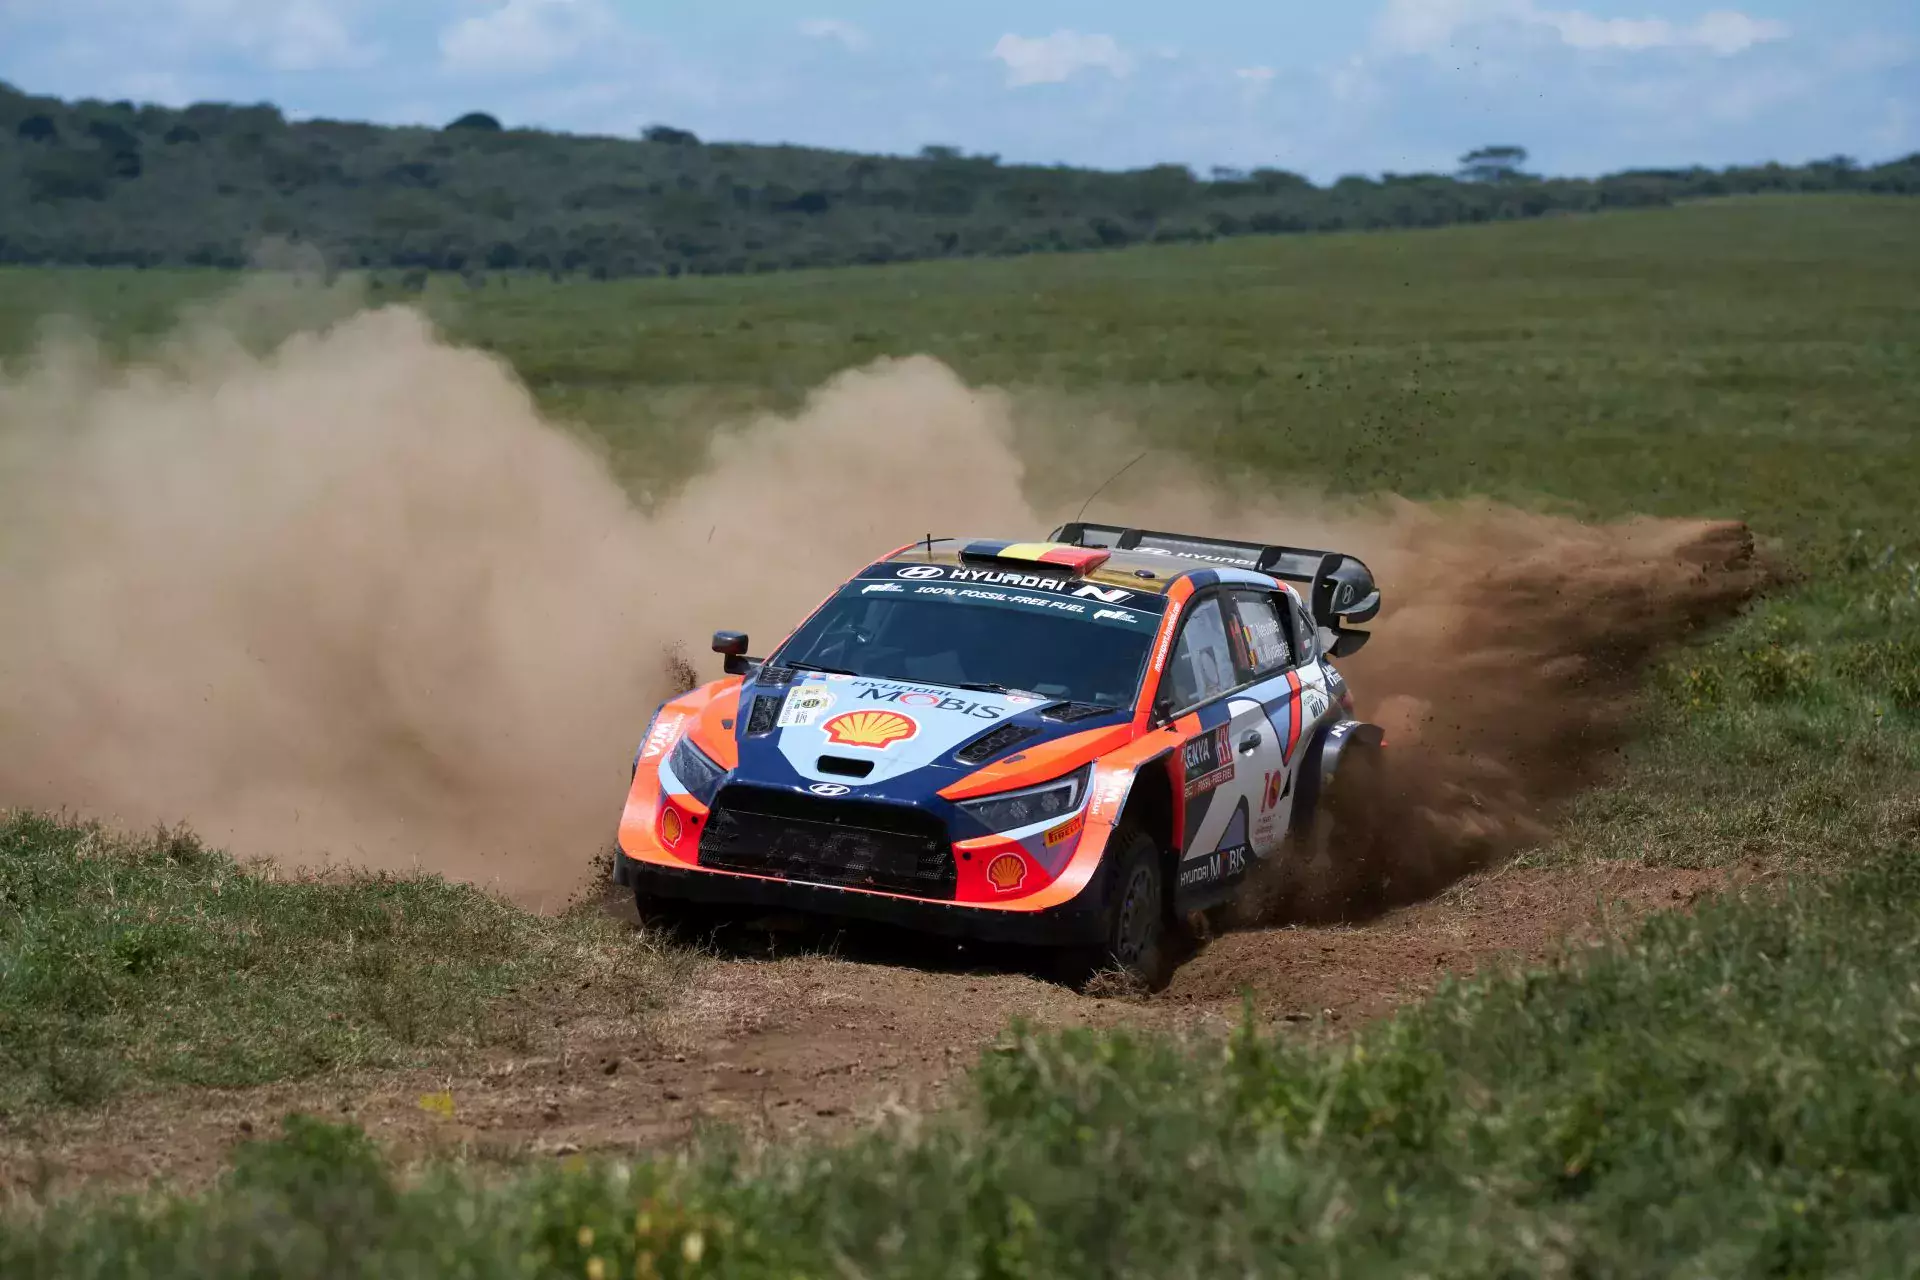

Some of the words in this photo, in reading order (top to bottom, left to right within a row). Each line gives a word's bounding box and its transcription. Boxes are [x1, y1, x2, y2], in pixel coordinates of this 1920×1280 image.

[949, 568, 1066, 592] HYUNDAI
[914, 586, 956, 596] 100%
[958, 588, 1050, 607] FOSSIL-FREE
[1049, 599, 1086, 614] FUEL
[850, 681, 950, 698] HYUNDAI
[855, 687, 1006, 720] MOBIS
[1309, 697, 1327, 719] WIA
[1047, 817, 1081, 844] PIRELLI
[1180, 864, 1209, 887] HYUNDAI
